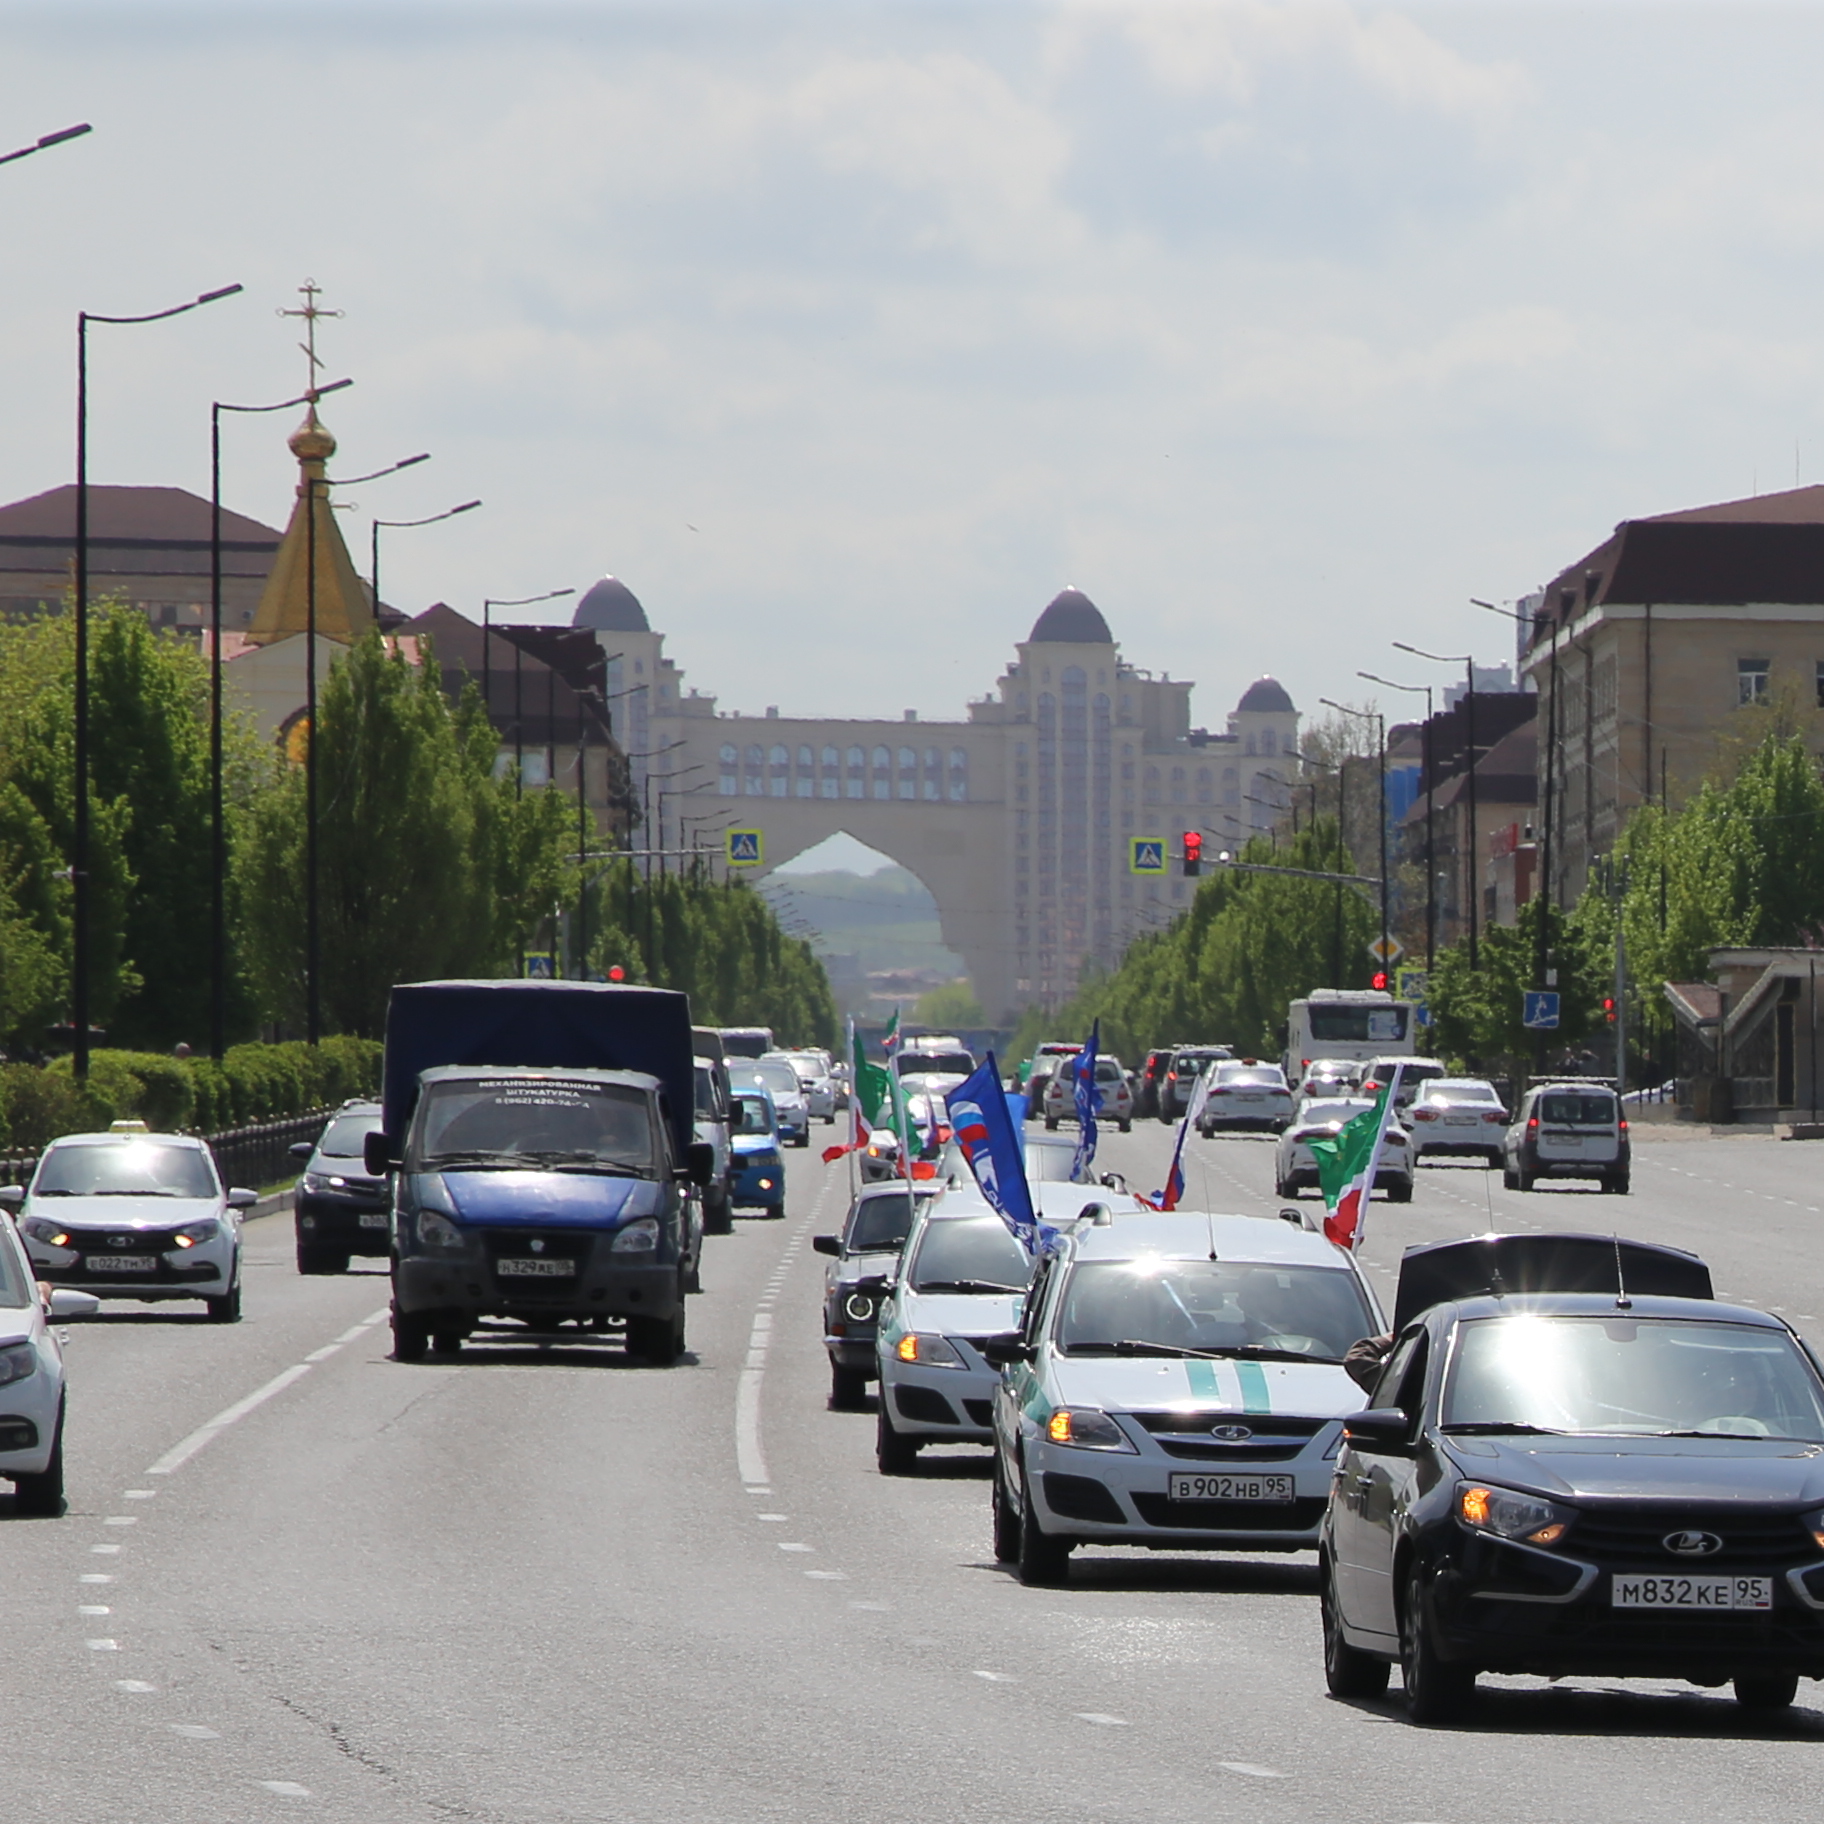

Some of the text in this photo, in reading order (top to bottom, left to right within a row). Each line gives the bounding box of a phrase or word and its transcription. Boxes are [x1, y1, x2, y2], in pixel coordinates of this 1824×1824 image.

[479, 1080, 601, 1091] МЕХАНИЗИРОВАННАЯ
[506, 1088, 581, 1098] ШТУКАТУРКА
[1180, 1478, 1286, 1498] В902НВ 95
[1622, 1579, 1763, 1605] М832КЕ 95
